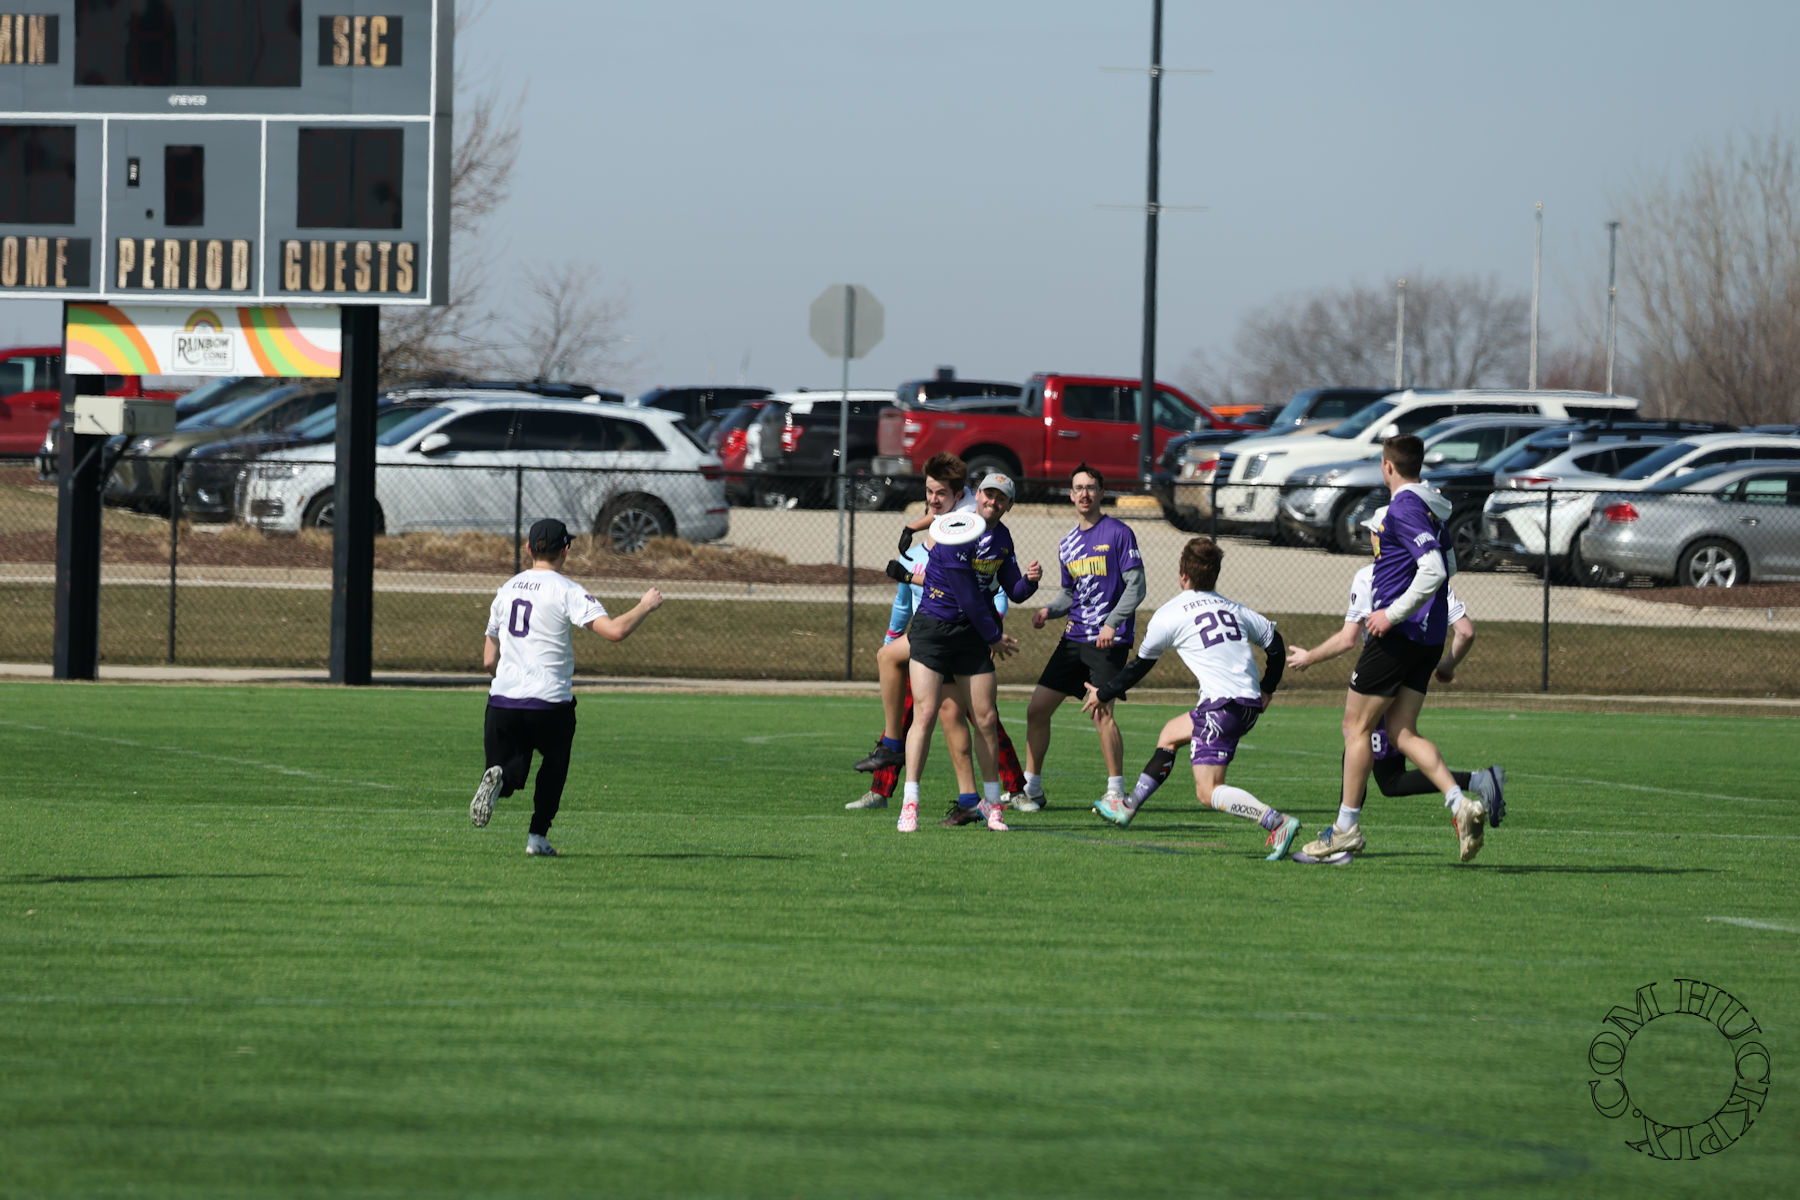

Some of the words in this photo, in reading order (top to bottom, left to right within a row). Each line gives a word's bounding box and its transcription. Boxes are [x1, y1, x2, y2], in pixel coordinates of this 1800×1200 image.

[332, 15, 388, 67] SEC
[1, 236, 69, 288] OME
[118, 237, 250, 291] PERIOD
[285, 240, 415, 293] GUESTS
[512, 582, 541, 591] COACH
[508, 598, 533, 638] 0
[1194, 609, 1242, 649] 29
